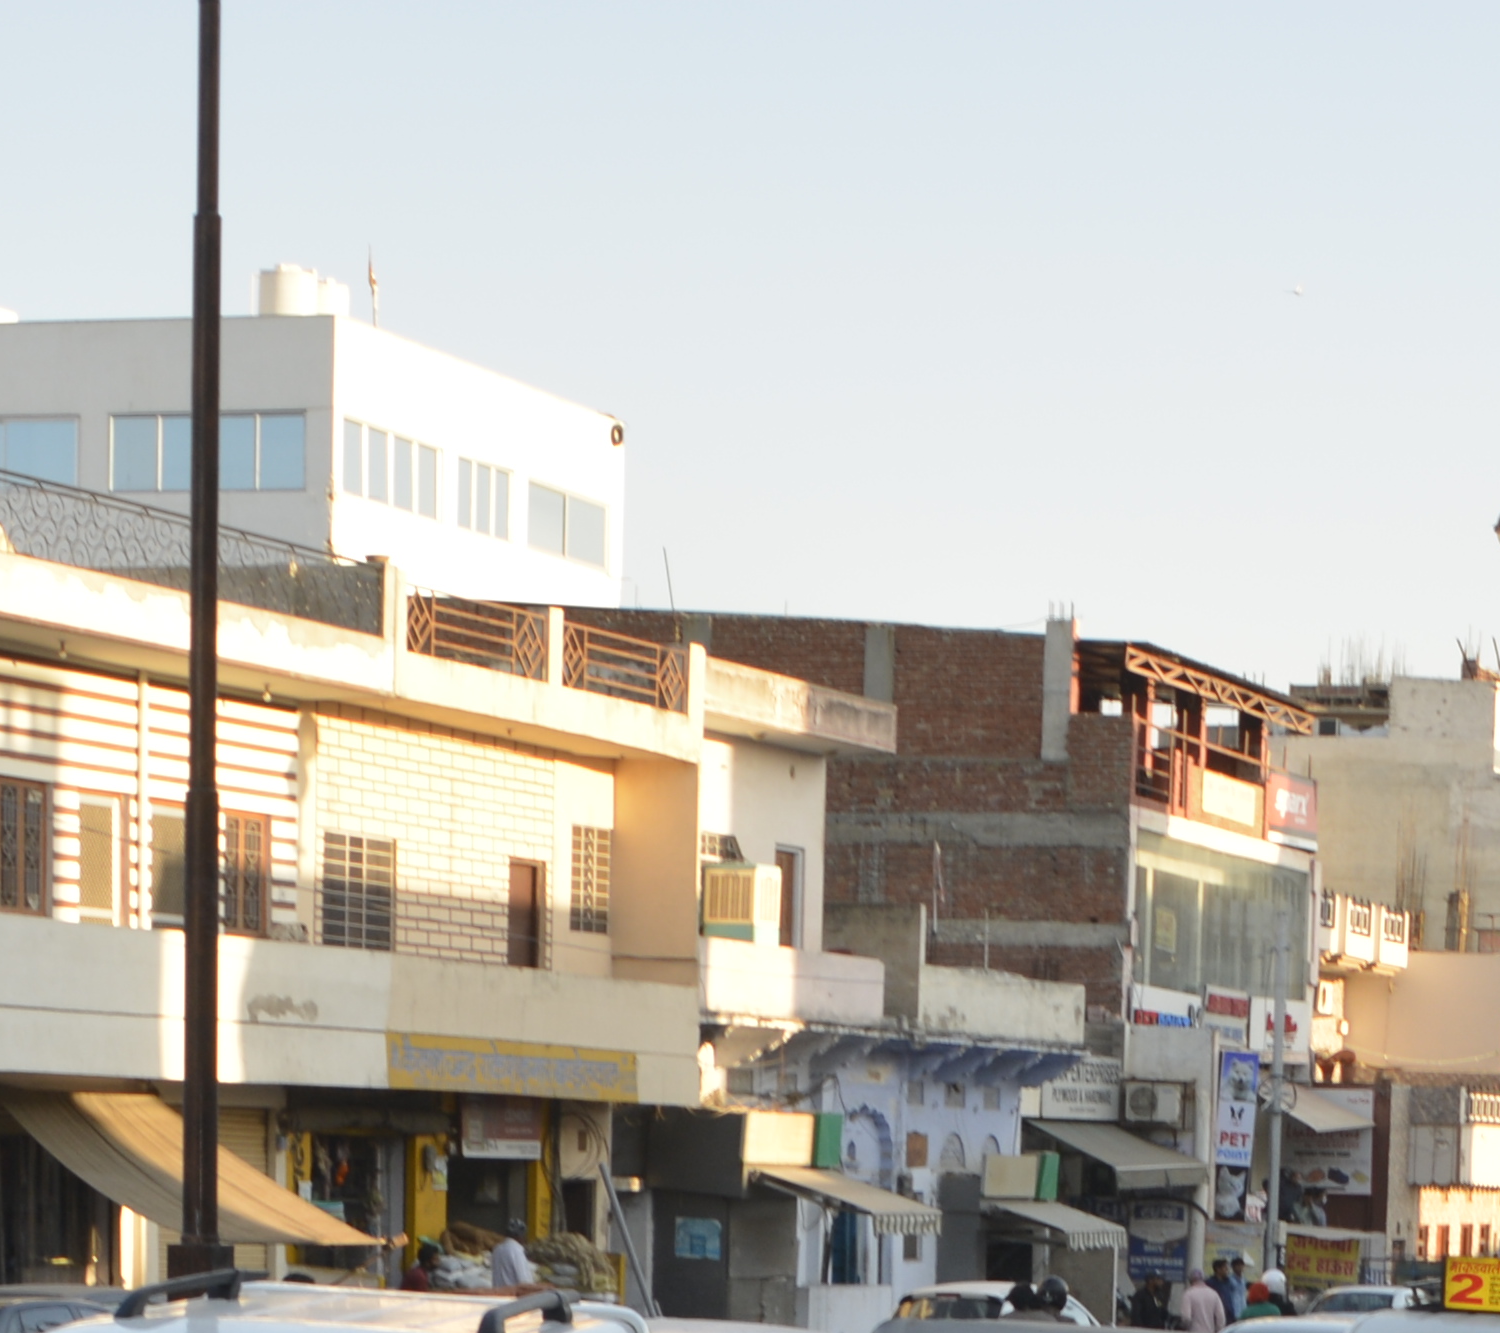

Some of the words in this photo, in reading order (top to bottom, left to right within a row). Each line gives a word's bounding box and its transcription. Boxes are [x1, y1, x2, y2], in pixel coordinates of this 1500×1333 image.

[1219, 1131, 1250, 1147] PET
[1216, 1149, 1250, 1162] POINT
[1450, 1273, 1484, 1305] 2
